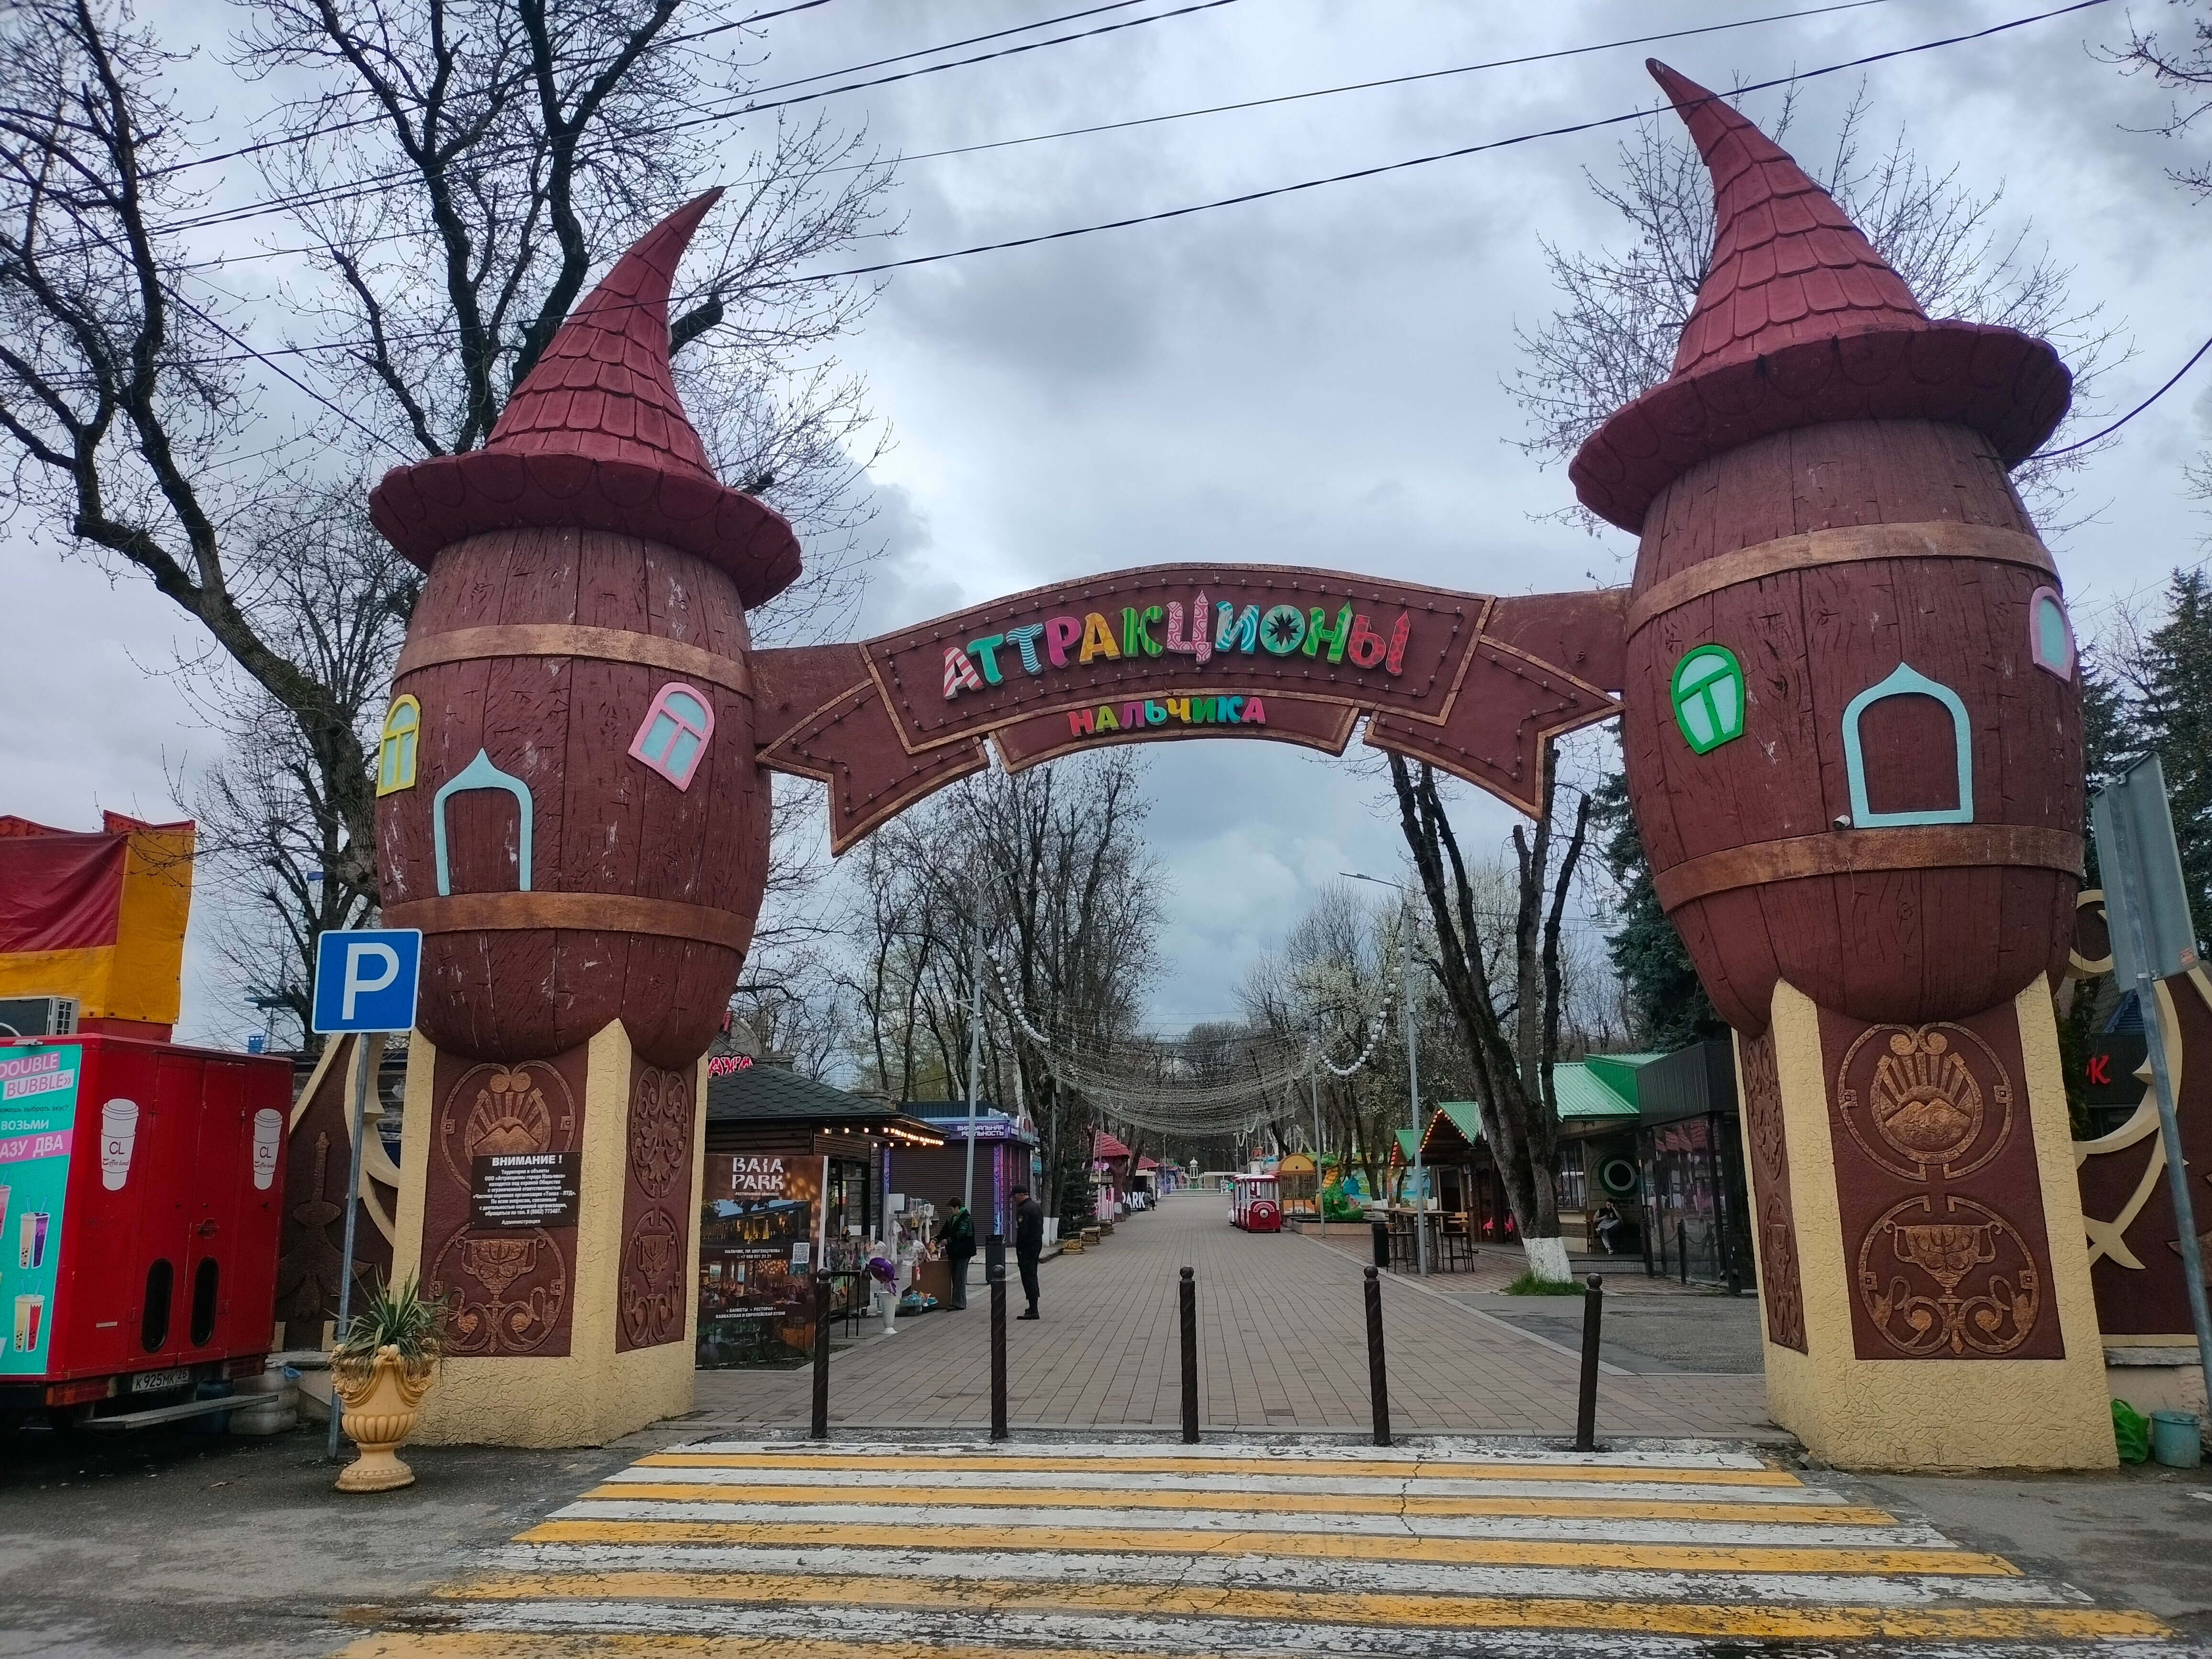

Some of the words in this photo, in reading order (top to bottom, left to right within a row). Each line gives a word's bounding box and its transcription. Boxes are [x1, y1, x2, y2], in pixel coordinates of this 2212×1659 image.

[943, 589, 1411, 700] АТТРАКЦИОНЫ
[1067, 696, 1266, 737] НАЛЬЧИКА
[342, 943, 399, 1020] P
[0, 1054, 58, 1078] DOUBLE
[7, 1073, 71, 1097] BUBBLE»
[1, 1119, 49, 1130] ВОЗЬМИ
[33, 1135, 63, 1158] ДВА
[110, 1141, 125, 1154] CL
[260, 1146, 272, 1158] CL
[492, 1155, 556, 1166] ВНИМАНИЕ
[733, 1158, 784, 1172] BAIA
[732, 1174, 784, 1189] PARK
